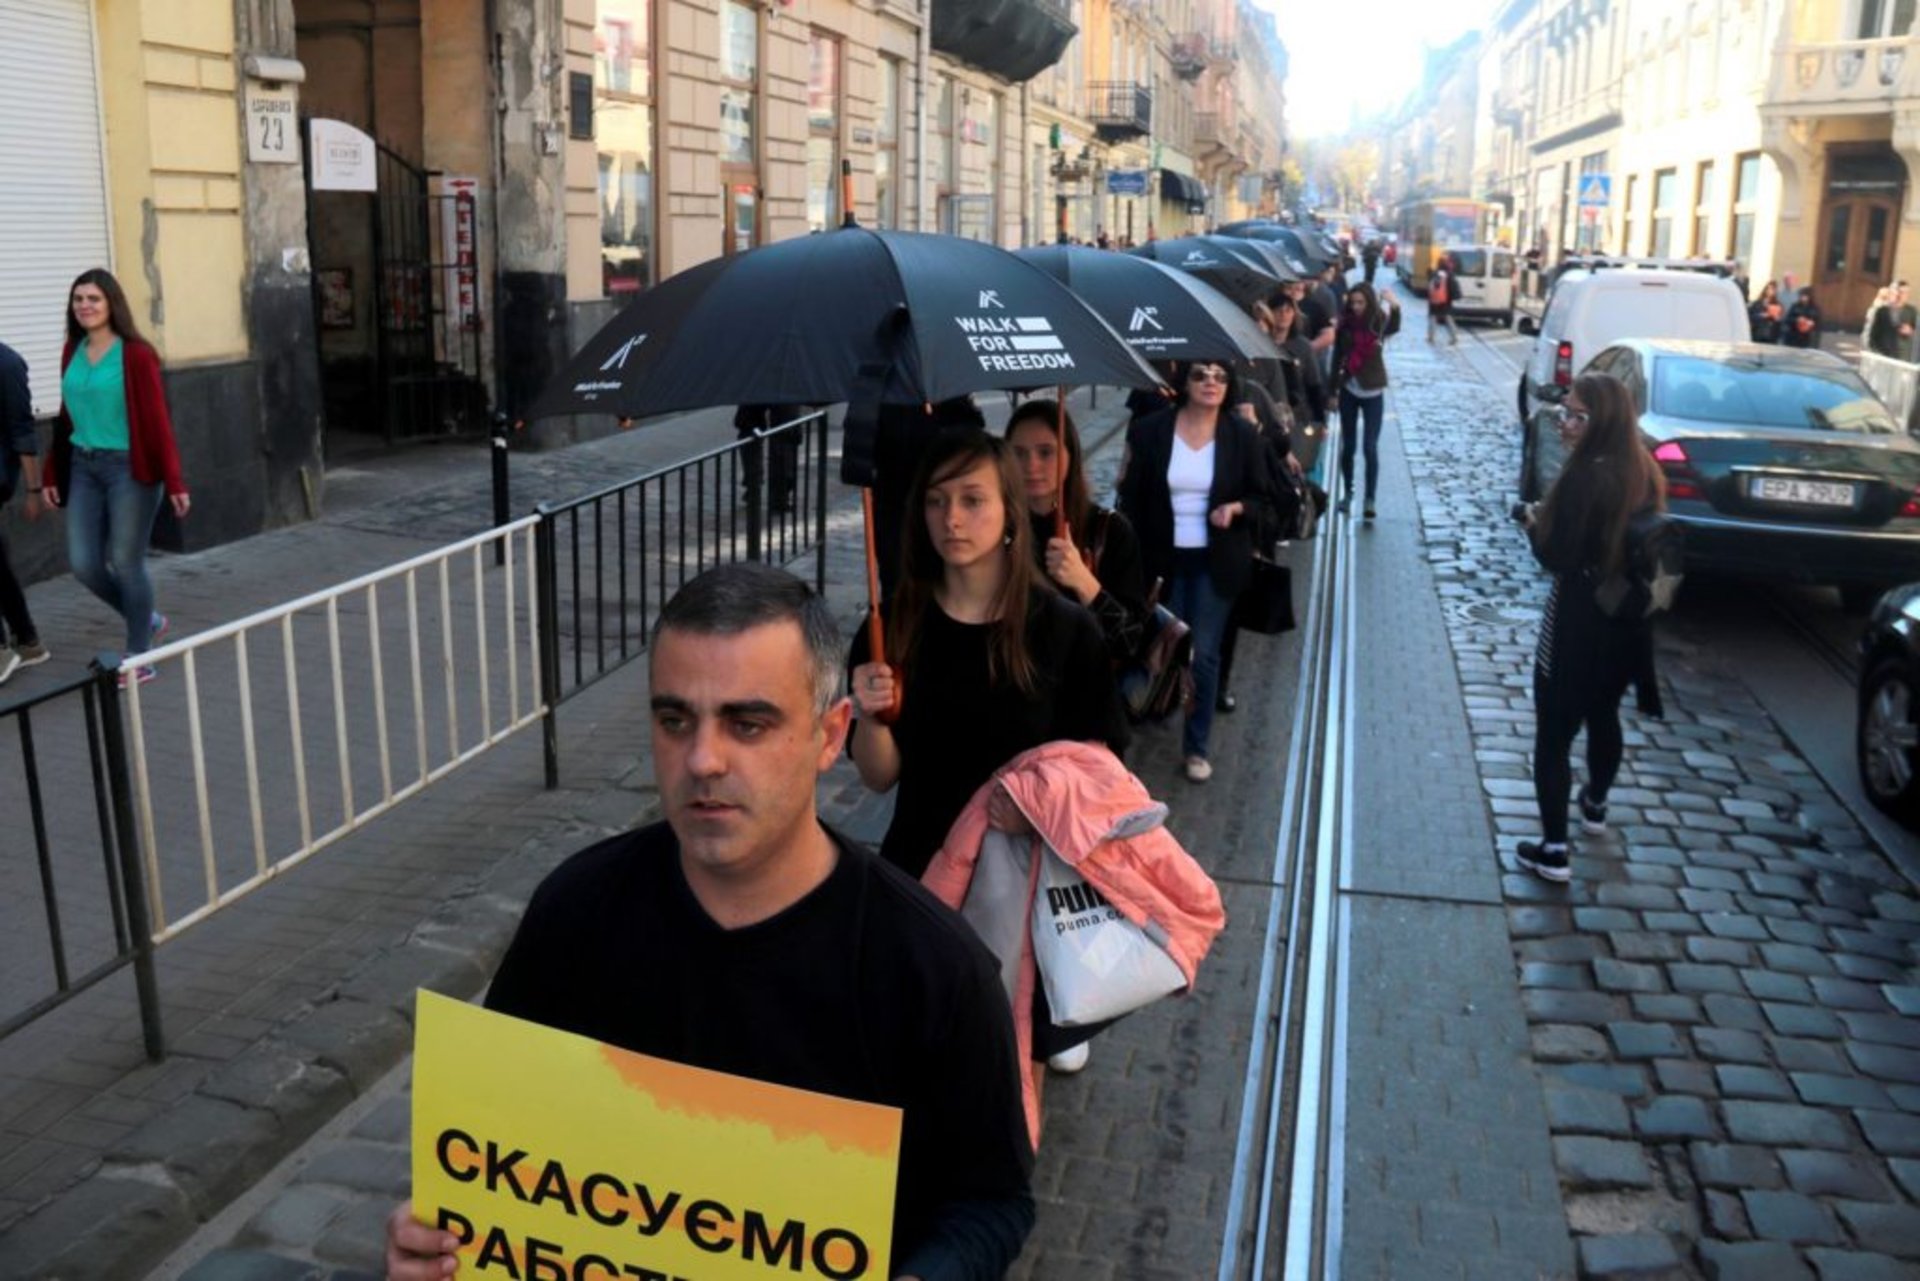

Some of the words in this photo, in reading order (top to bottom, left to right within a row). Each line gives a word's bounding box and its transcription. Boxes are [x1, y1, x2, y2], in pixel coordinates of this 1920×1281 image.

[260, 115, 284, 151] 23
[954, 316, 1018, 333] WALK
[967, 335, 1011, 352] FOR
[978, 352, 1076, 372] FREEDOM
[1047, 881, 1112, 916] PUM
[436, 1128, 869, 1281] СКАСУЄМО
[437, 1207, 690, 1281] РАБС
